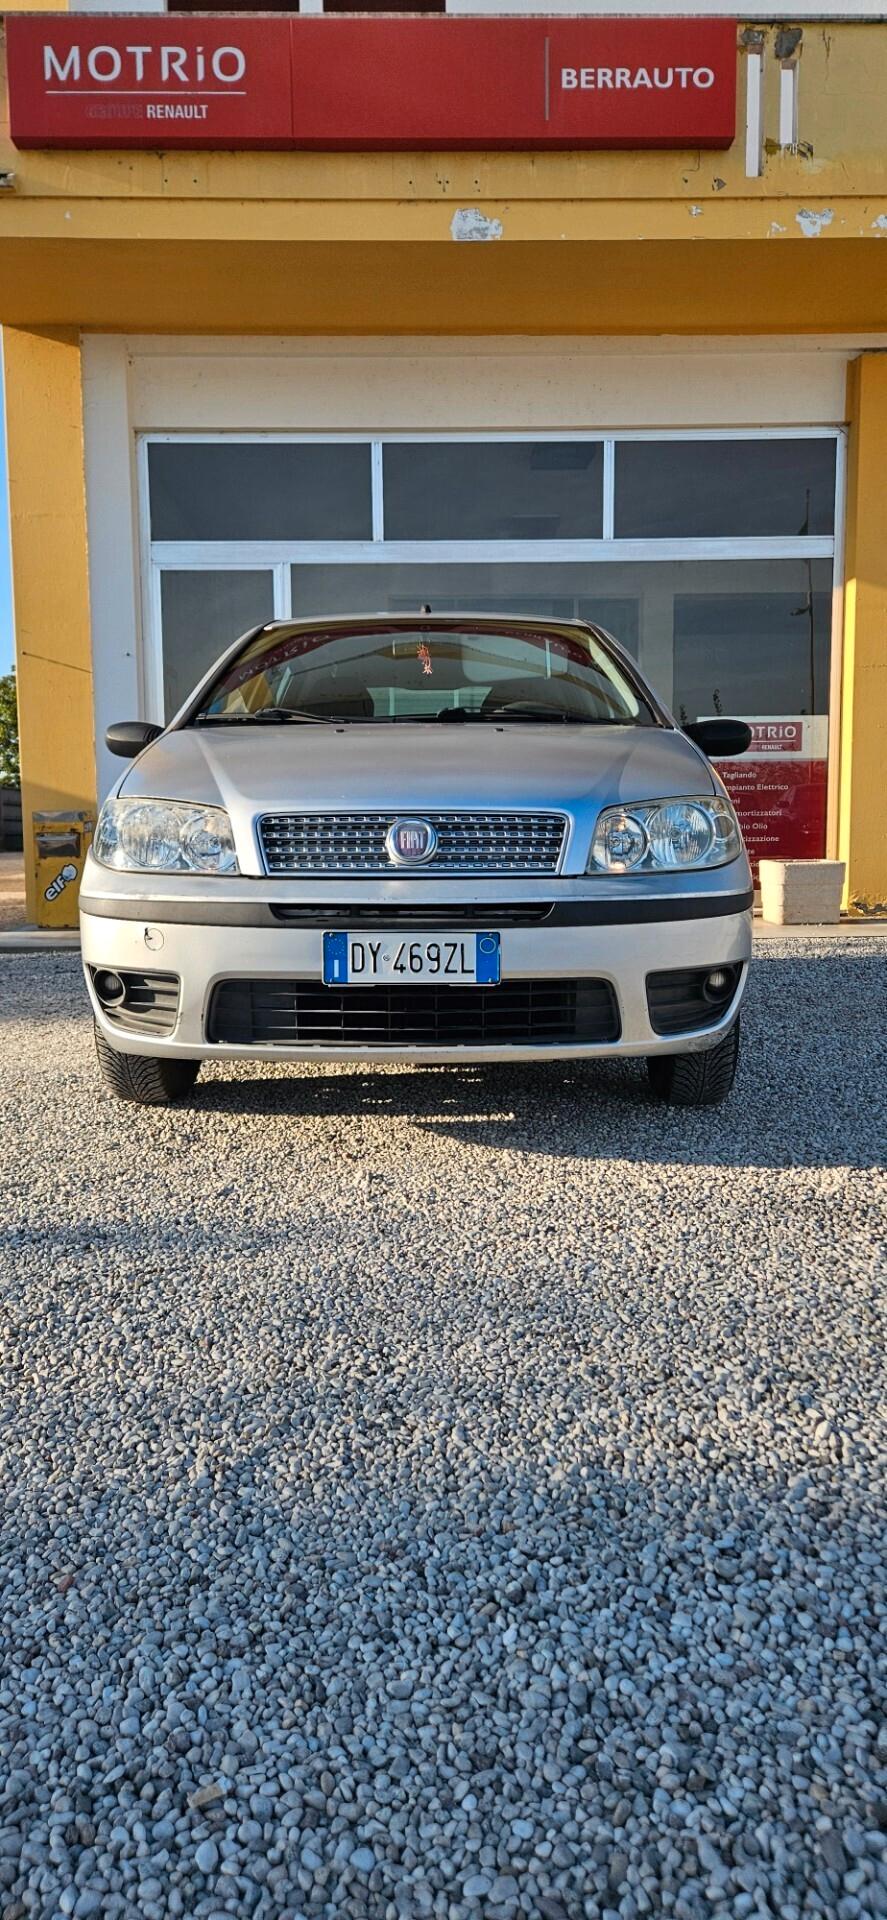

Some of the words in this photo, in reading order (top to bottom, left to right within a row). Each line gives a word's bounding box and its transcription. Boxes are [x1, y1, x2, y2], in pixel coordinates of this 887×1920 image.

[561, 67, 715, 90] BERRAUTO
[146, 104, 208, 119] RENAULT
[722, 771, 757, 780] Tagliando
[752, 822, 768, 830] Olio
[400, 830, 427, 849] FIAT
[45, 873, 66, 901] elf
[351, 942, 382, 974] DY
[392, 942, 475, 974] 469ZL
